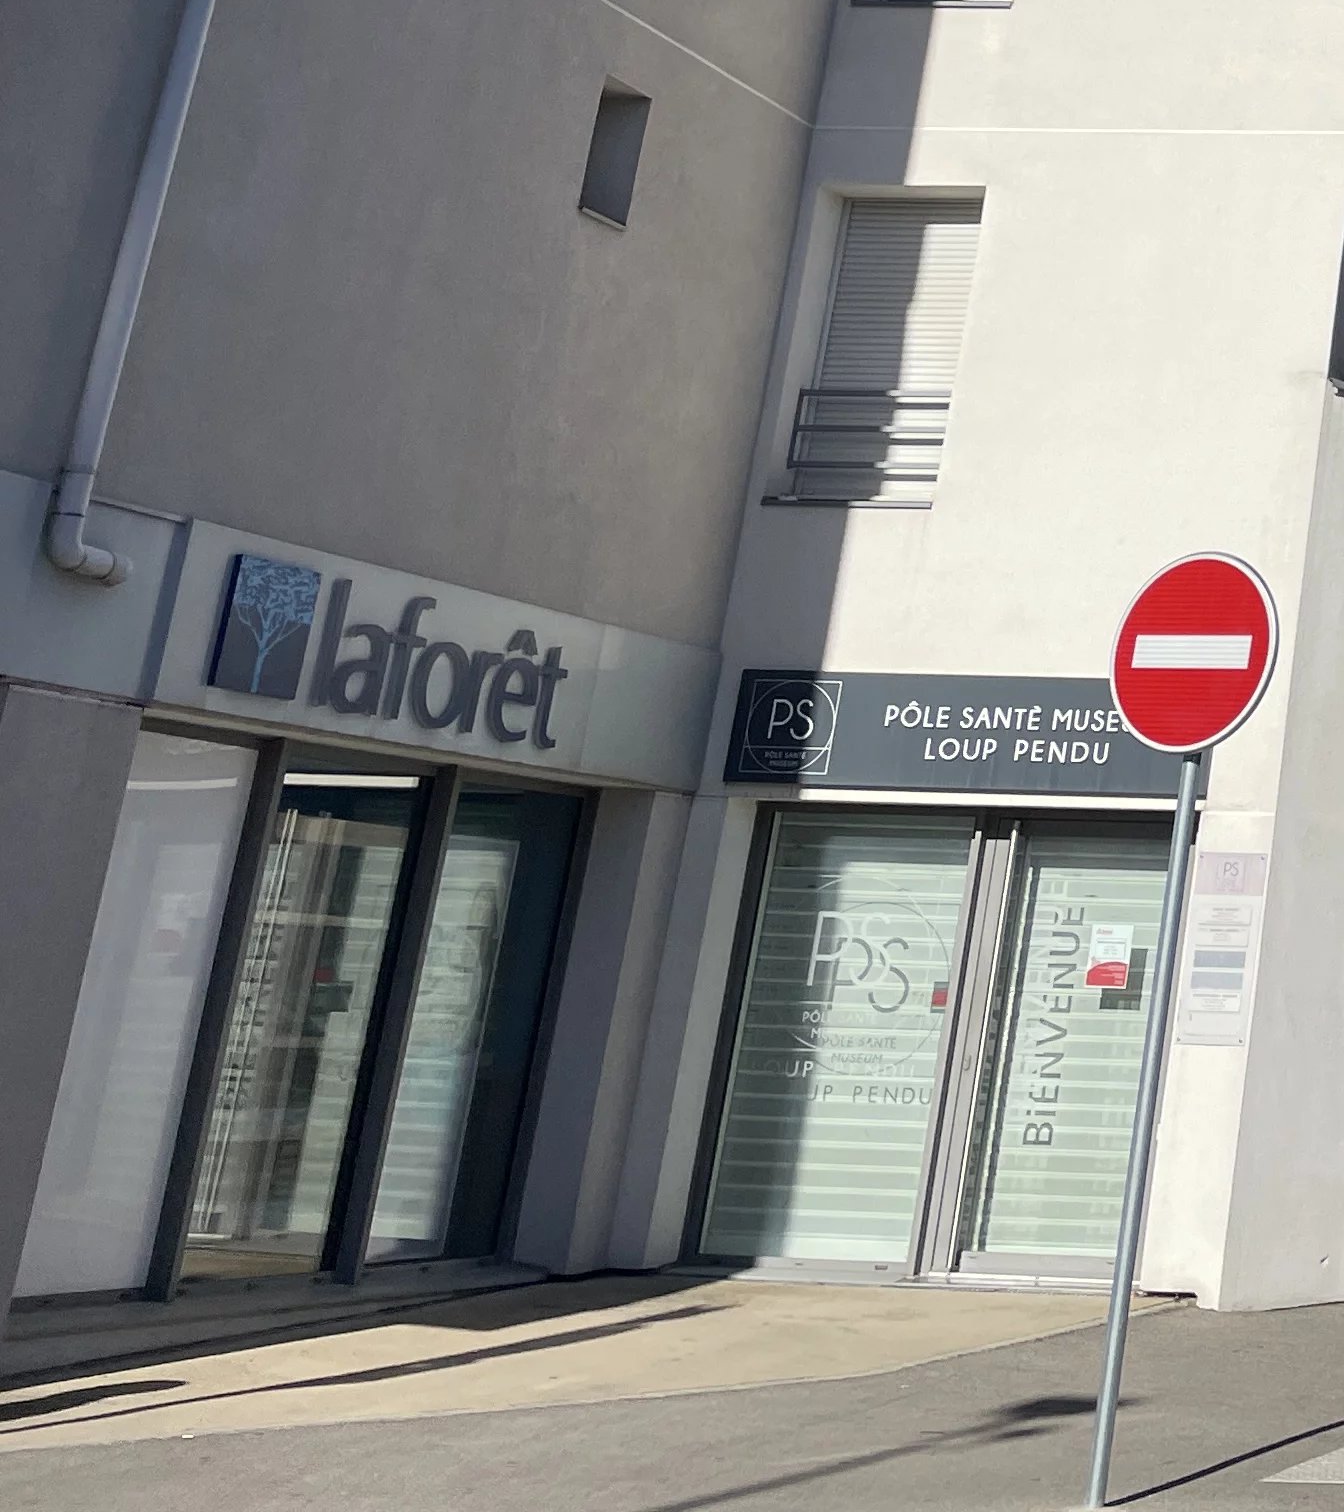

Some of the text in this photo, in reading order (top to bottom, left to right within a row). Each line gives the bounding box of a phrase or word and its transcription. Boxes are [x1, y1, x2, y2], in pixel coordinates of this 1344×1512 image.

[308, 578, 568, 749] laforêt
[766, 698, 814, 740] PS
[883, 700, 951, 729] PÔLE
[1051, 709, 1130, 733] MUSE
[923, 737, 1110, 765] LOUP PENDU
[1224, 861, 1240, 877] PS
[852, 1085, 932, 1106] PENDU
